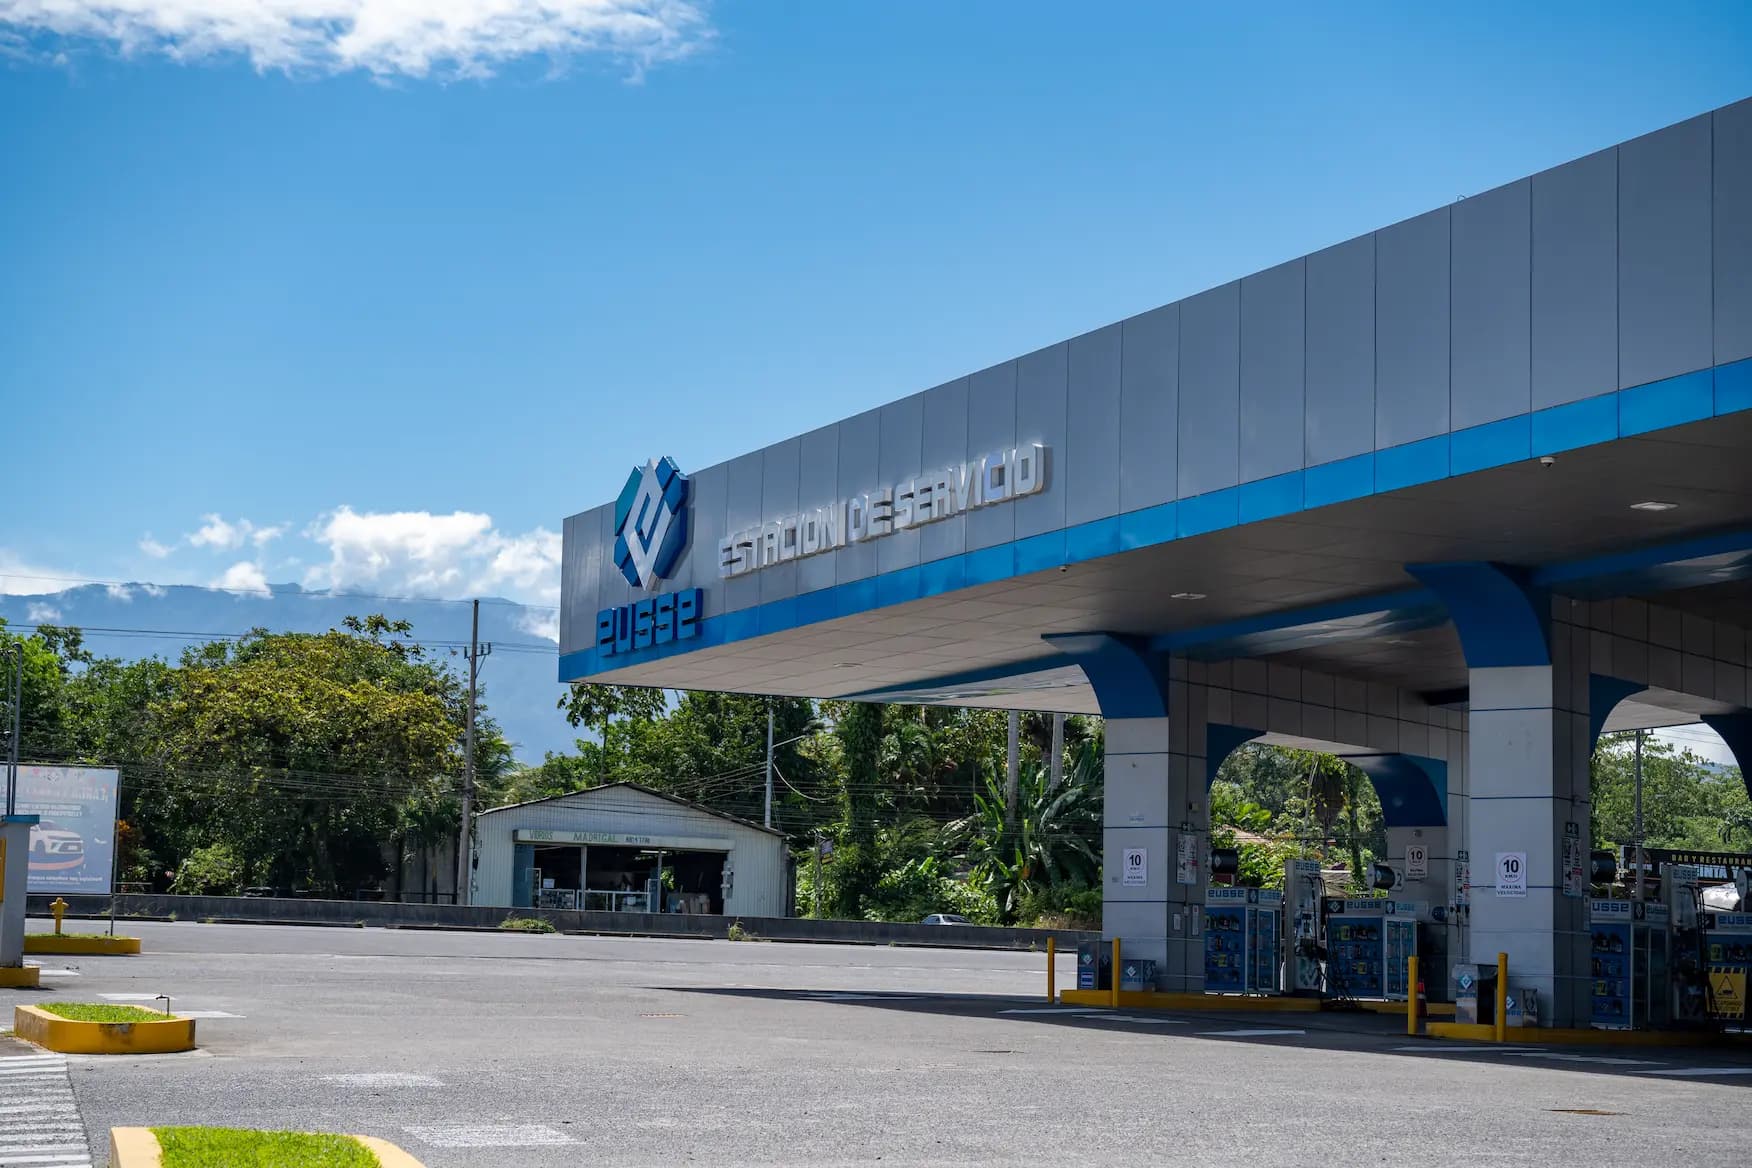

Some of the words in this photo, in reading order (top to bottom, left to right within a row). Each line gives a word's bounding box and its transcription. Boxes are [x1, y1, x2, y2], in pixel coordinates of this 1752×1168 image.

[719, 503, 848, 579] ESTACION
[848, 488, 893, 542] DE
[894, 443, 1048, 530] SERVICIO
[572, 831, 616, 843] MADRIGAL
[1129, 854, 1141, 866] 10
[1411, 850, 1423, 860] 10
[1671, 854, 1690, 863] BAR
[1692, 855, 1697, 863] Y
[1699, 855, 1752, 865] RESTAURAN
[1503, 859, 1519, 873] 10
